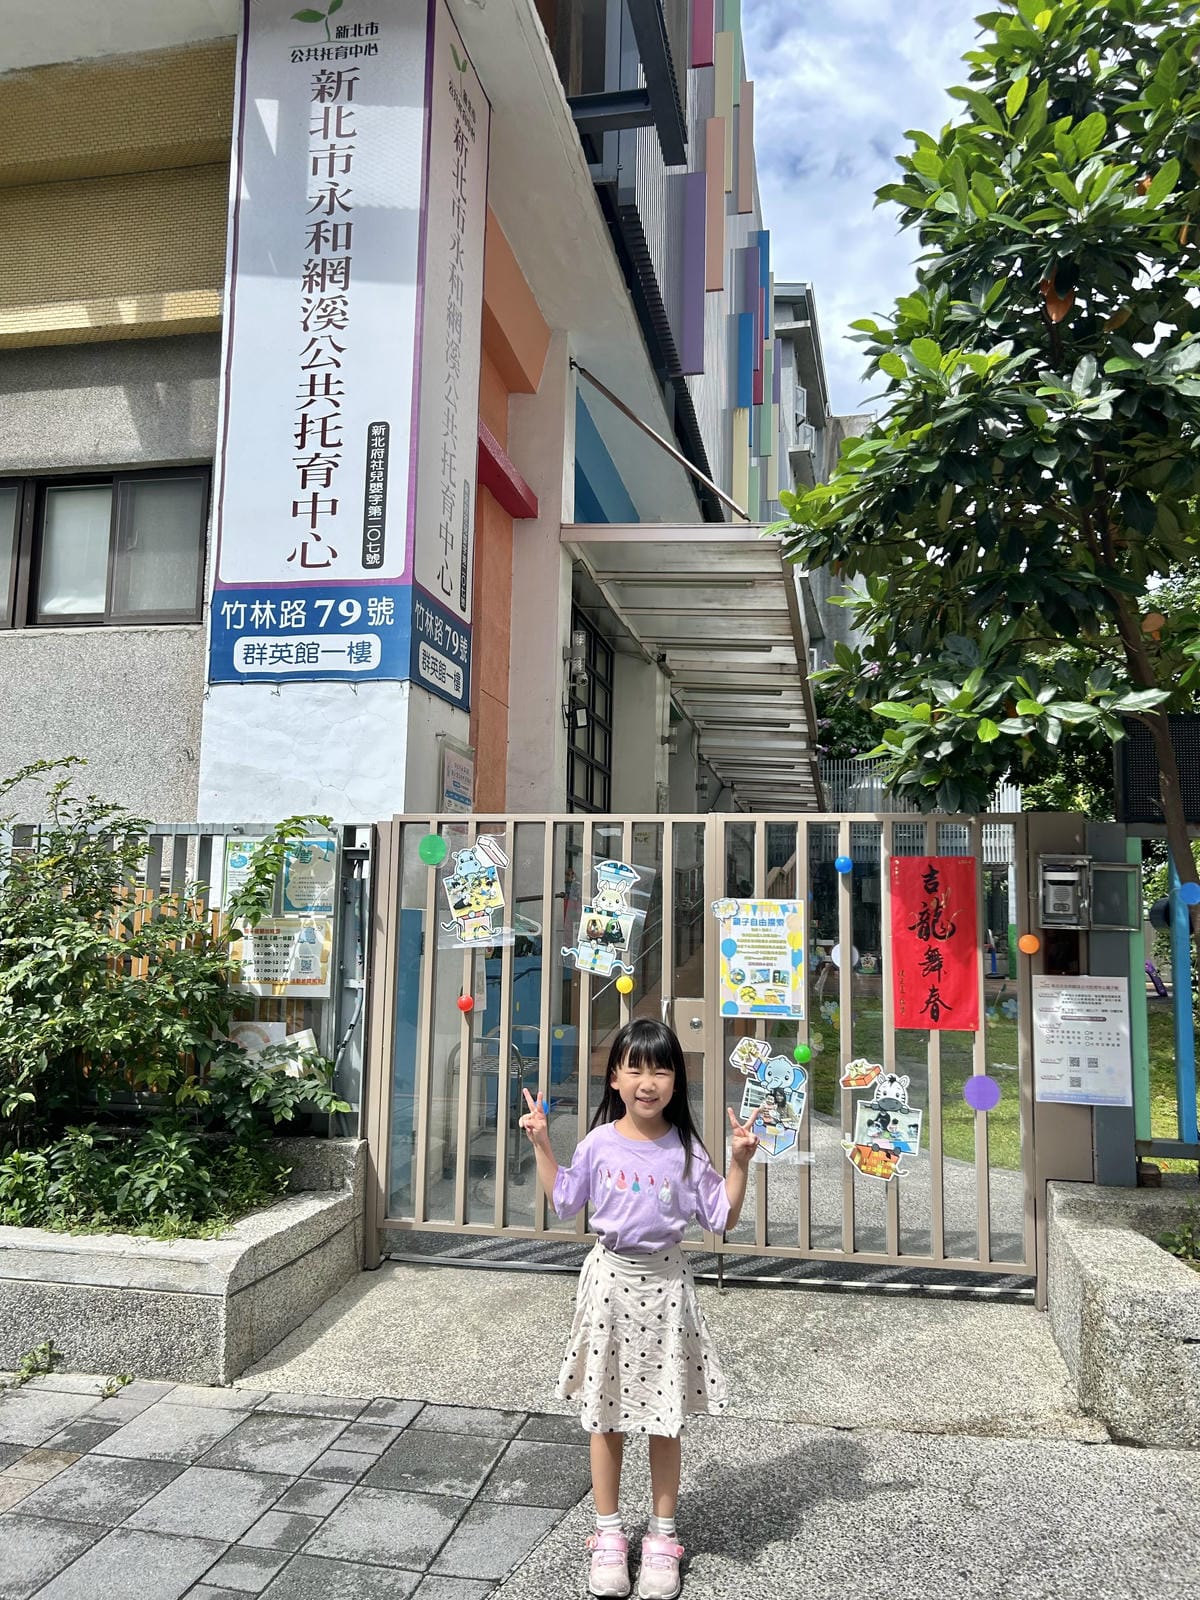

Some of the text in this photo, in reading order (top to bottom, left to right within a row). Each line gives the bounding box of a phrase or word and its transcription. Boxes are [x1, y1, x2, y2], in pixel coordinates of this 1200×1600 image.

[336, 22, 379, 39] 新北市
[291, 43, 378, 63] 公共托育中心
[286, 67, 361, 568] 新北市永和網溪公共托育中心
[243, 640, 373, 666] 群英館一樓
[421, 648, 463, 693] 群英館一樓
